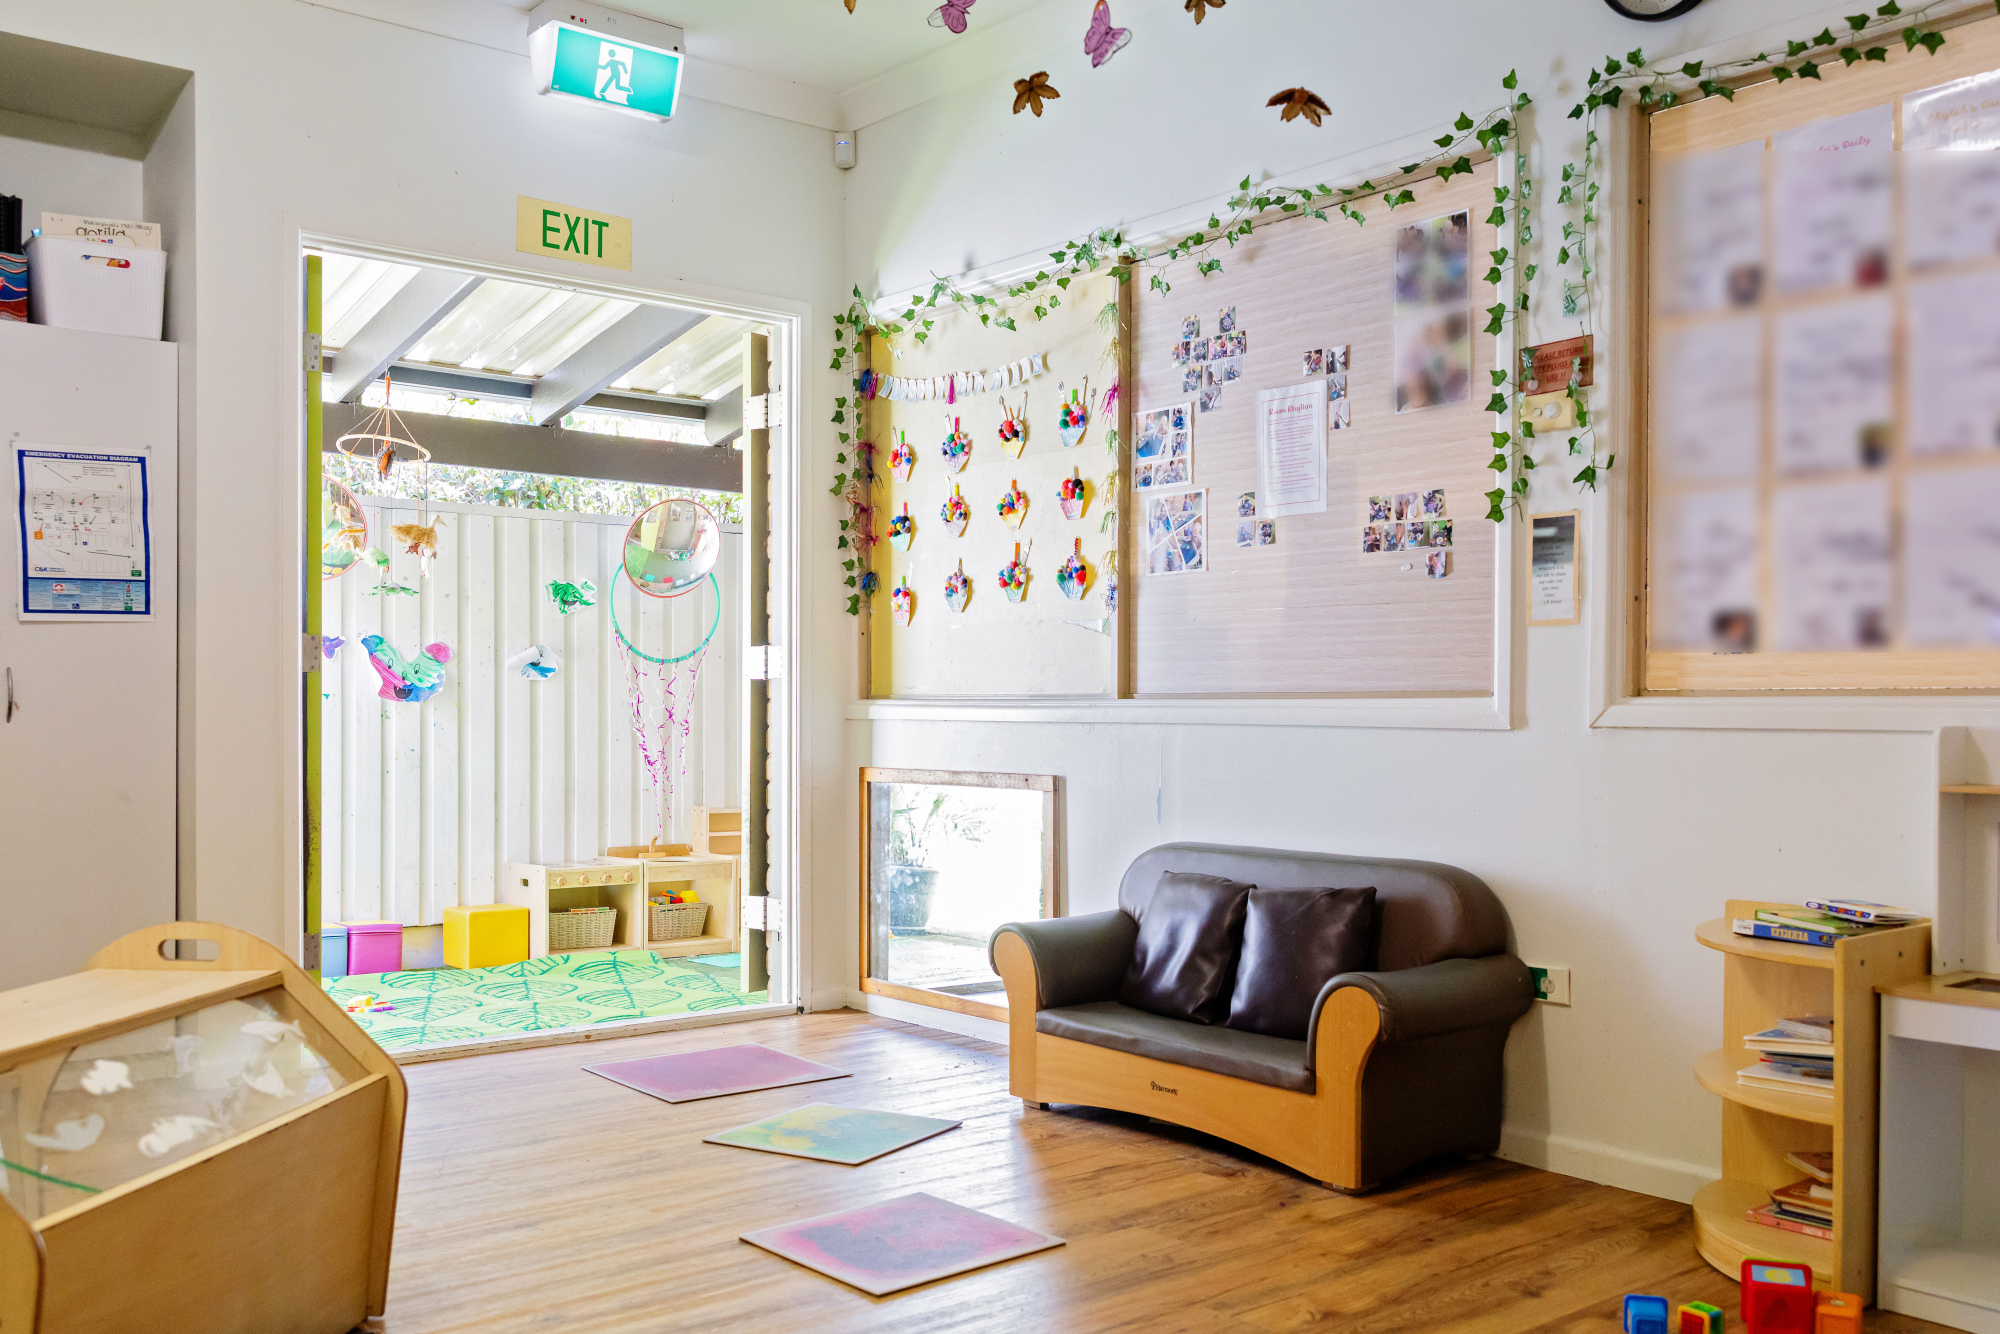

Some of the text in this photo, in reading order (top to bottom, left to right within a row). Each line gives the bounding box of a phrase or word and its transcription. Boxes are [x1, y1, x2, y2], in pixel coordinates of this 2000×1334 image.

[542, 209, 609, 258] EXIT
[1534, 346, 1583, 361] PLEASE RETURN
[1547, 361, 1567, 369] PLUGS
[1547, 374, 1558, 382] USE
[1287, 404, 1313, 413] Rhythm
[67, 453, 108, 461] EVACUATION
[1770, 927, 1808, 941] VEHICLES
